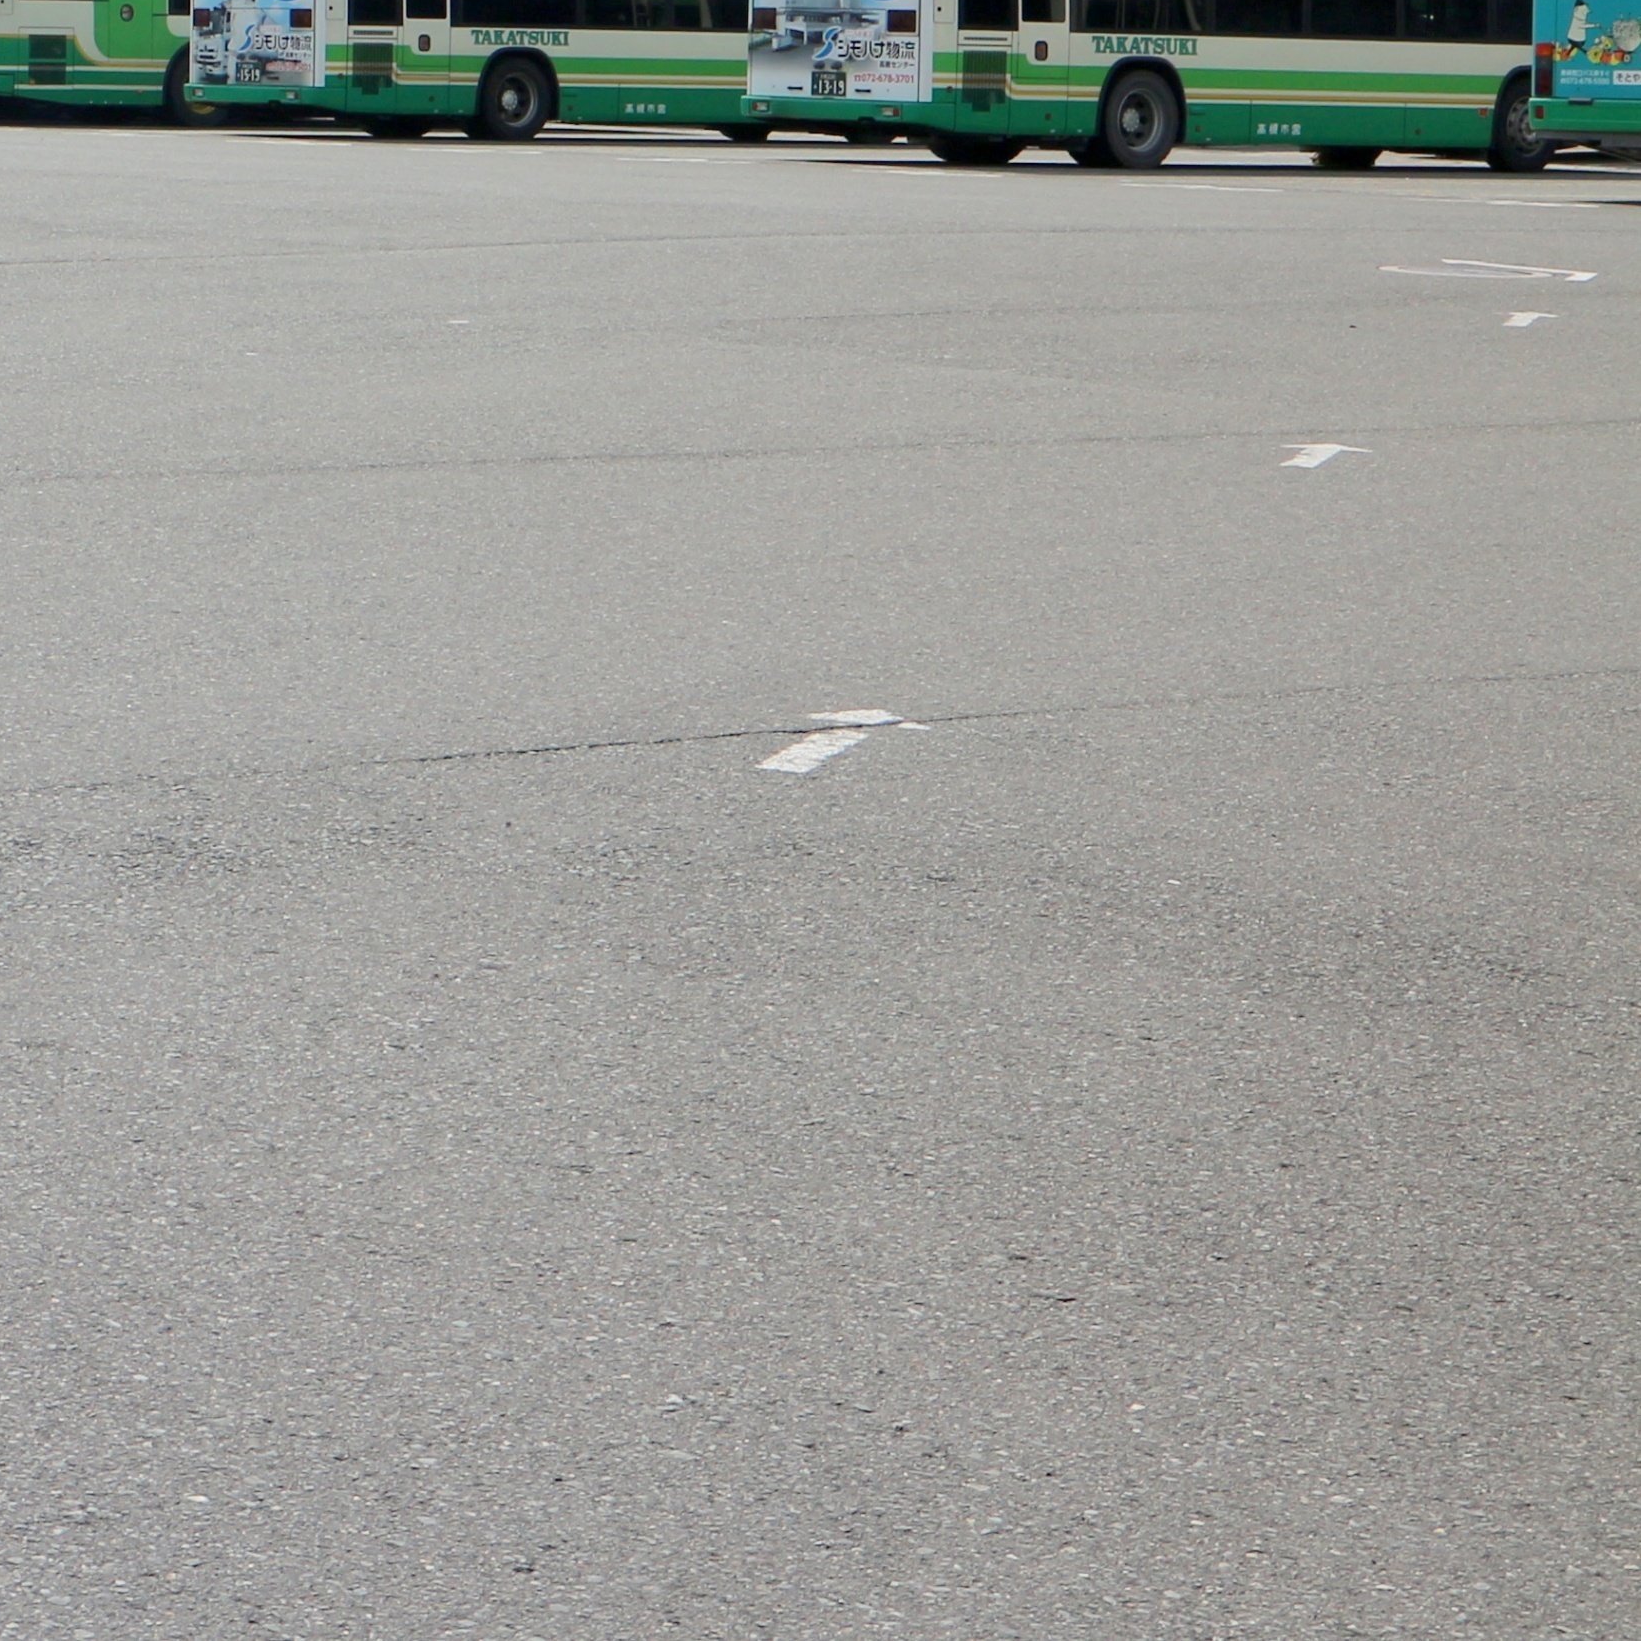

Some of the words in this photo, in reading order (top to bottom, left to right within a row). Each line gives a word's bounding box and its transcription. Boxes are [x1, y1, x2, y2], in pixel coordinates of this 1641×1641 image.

[471, 30, 570, 46] TAKATSUKI
[1092, 36, 1197, 56] TAKATSUKI
[819, 79, 845, 95] 13-19
